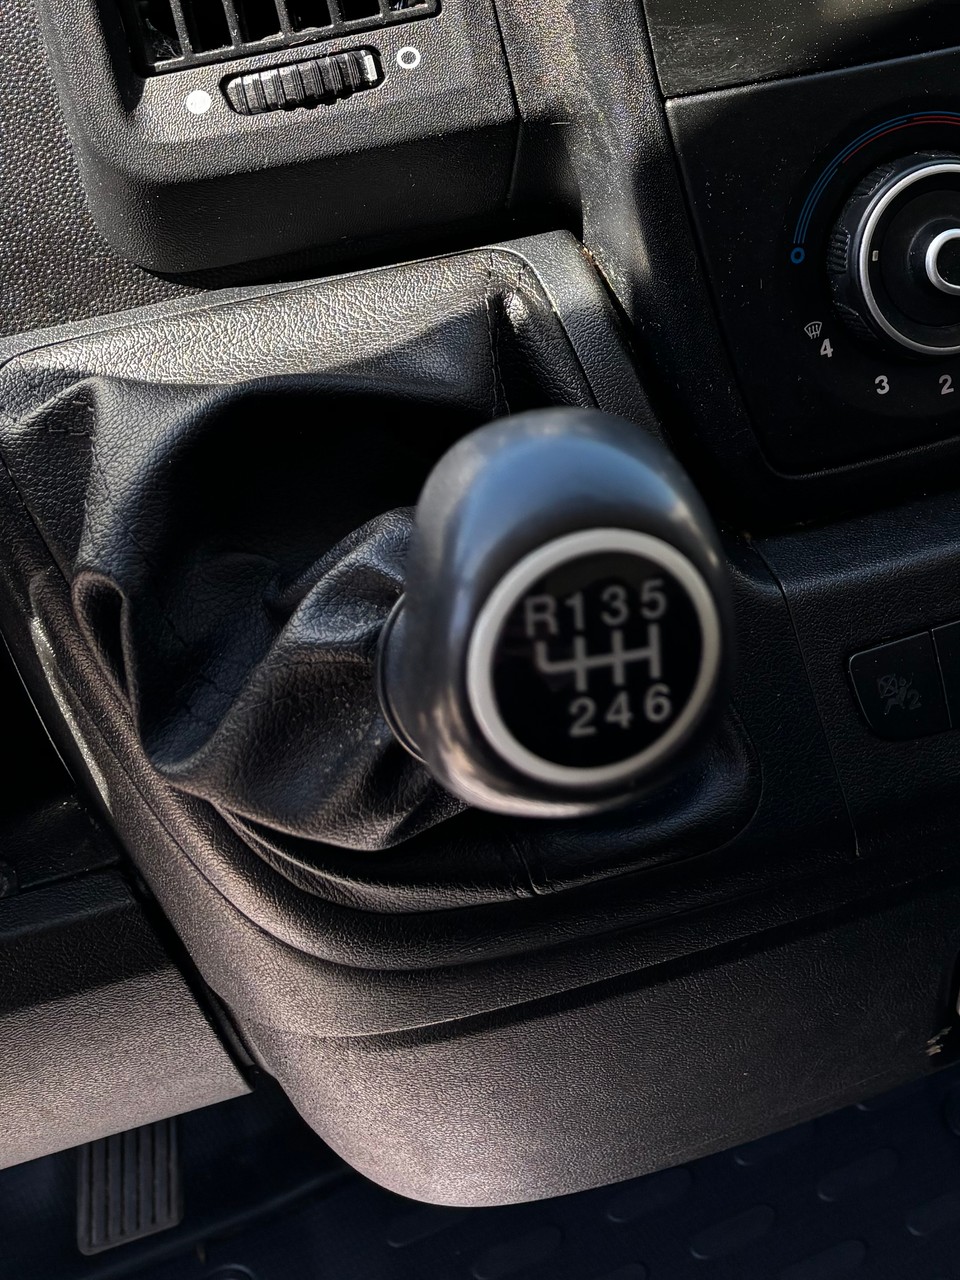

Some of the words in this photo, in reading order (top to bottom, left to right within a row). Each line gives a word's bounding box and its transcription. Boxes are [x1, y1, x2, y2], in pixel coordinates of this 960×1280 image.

[820, 338, 833, 358] 4
[874, 375, 890, 395] 3
[938, 374, 954, 395] 2
[525, 594, 558, 638] R
[564, 591, 584, 631] 1
[602, 585, 629, 625] 3
[641, 579, 666, 619] 5
[569, 696, 597, 737] 2
[605, 691, 633, 729] 4
[643, 683, 671, 722] 6
